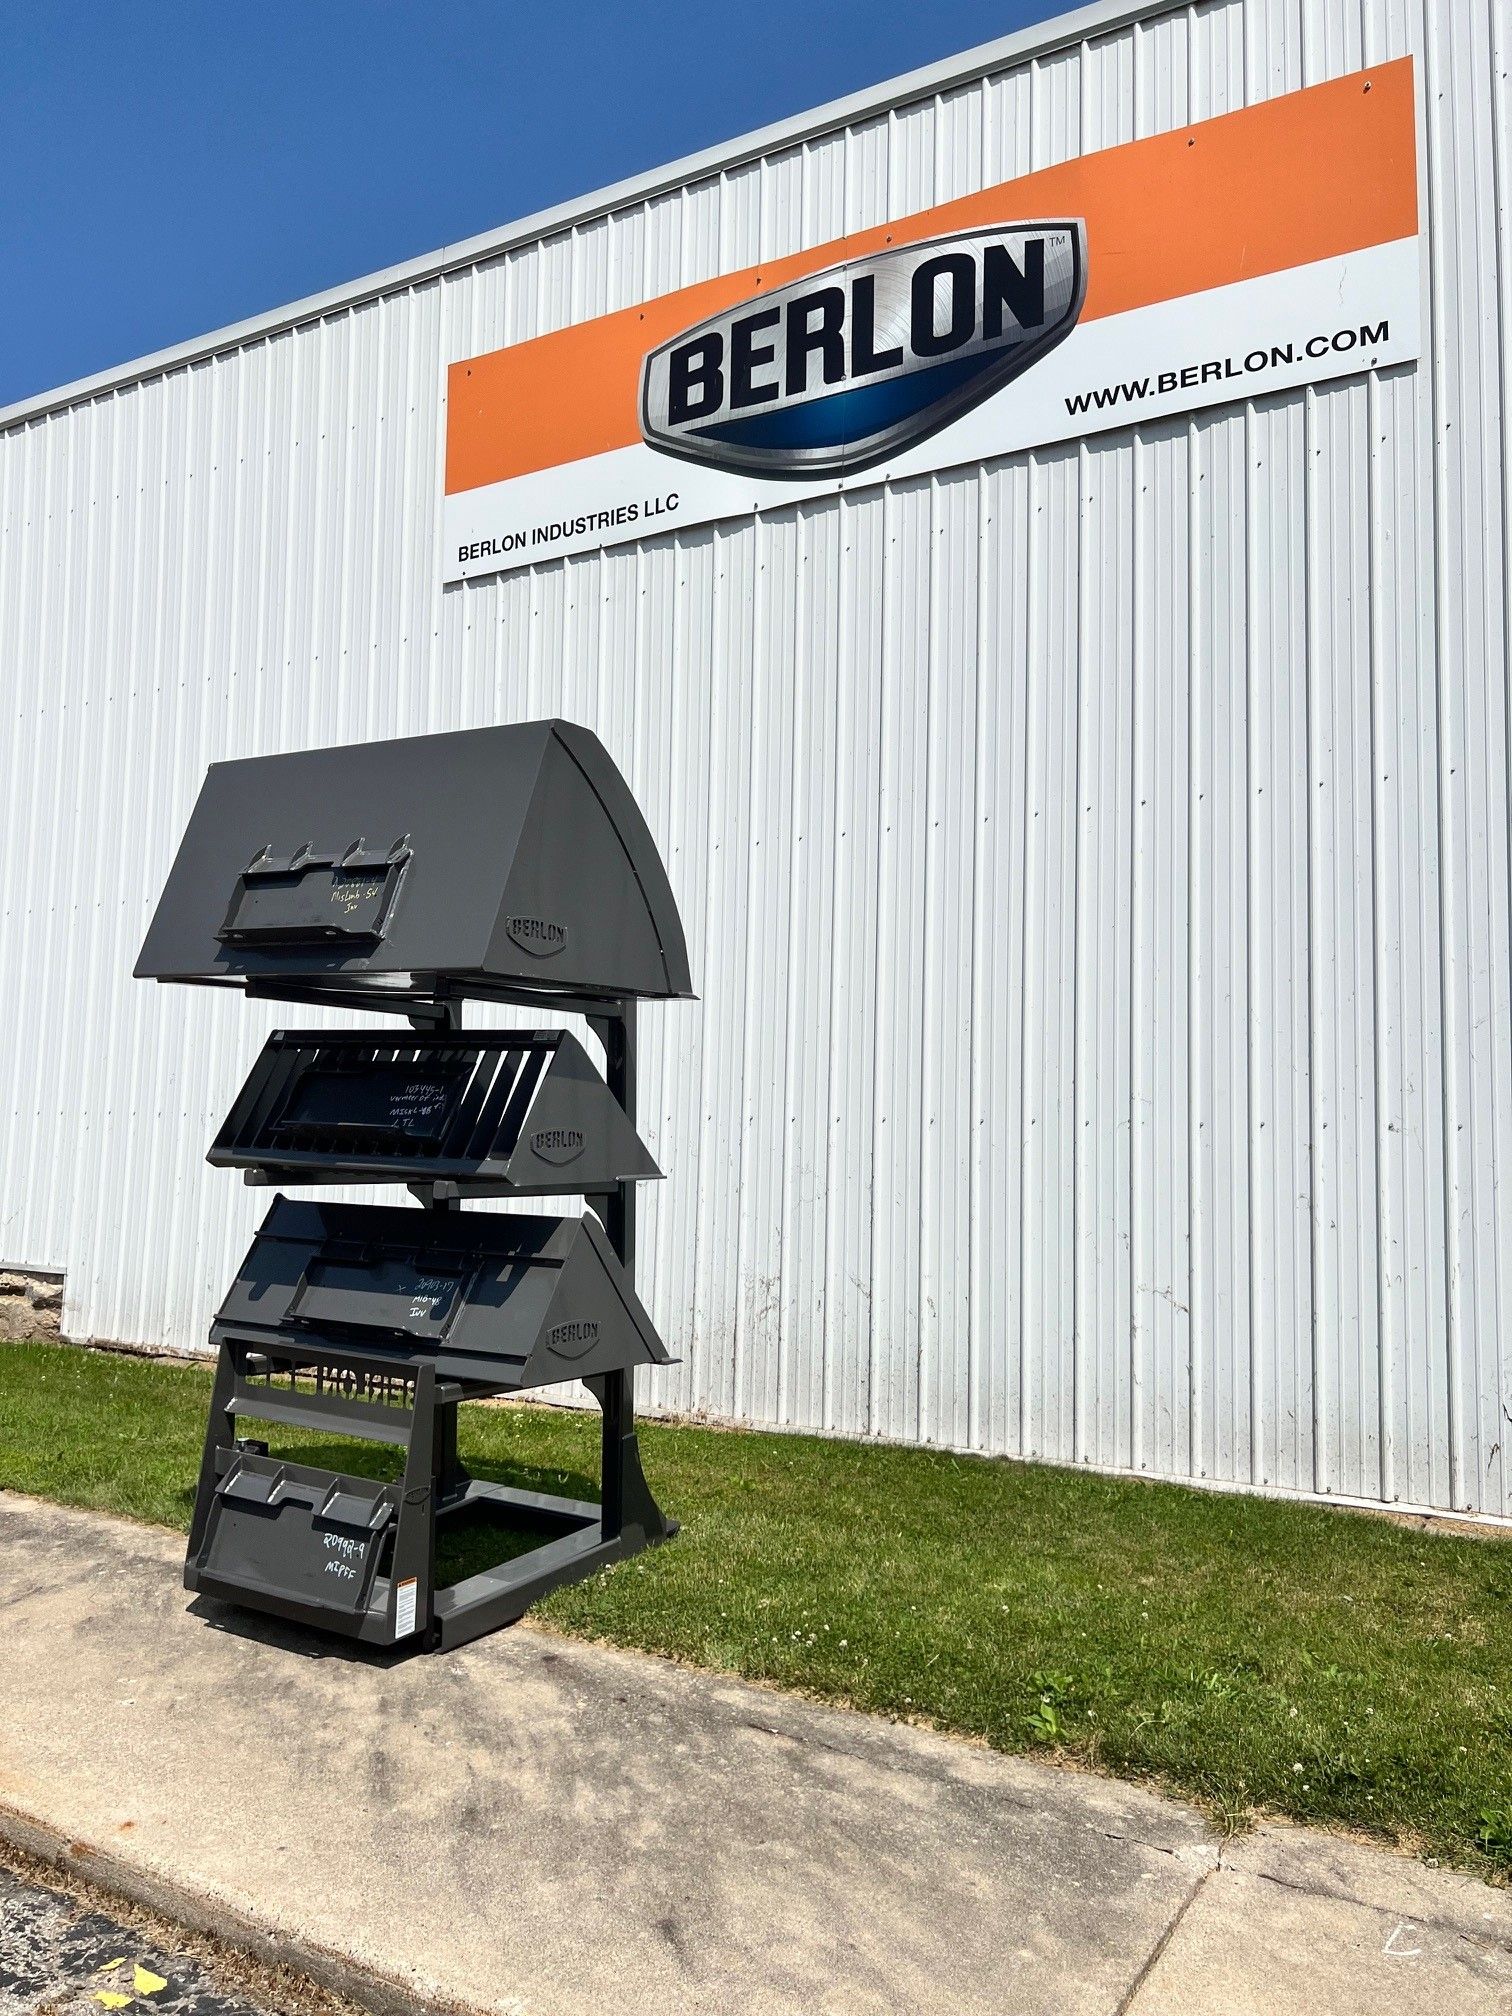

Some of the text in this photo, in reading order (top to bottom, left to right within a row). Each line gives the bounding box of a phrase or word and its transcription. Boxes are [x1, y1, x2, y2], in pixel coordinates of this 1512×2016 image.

[1049, 235, 1066, 247] TM
[668, 238, 1045, 427] BERLON
[1065, 320, 1390, 416] WWW.BERLON.COM
[458, 493, 680, 562] BERLON INDUSTRIES LLC
[512, 919, 564, 943] BERLON
[536, 1131, 583, 1149] BERLON
[551, 1322, 598, 1345] BERLON
